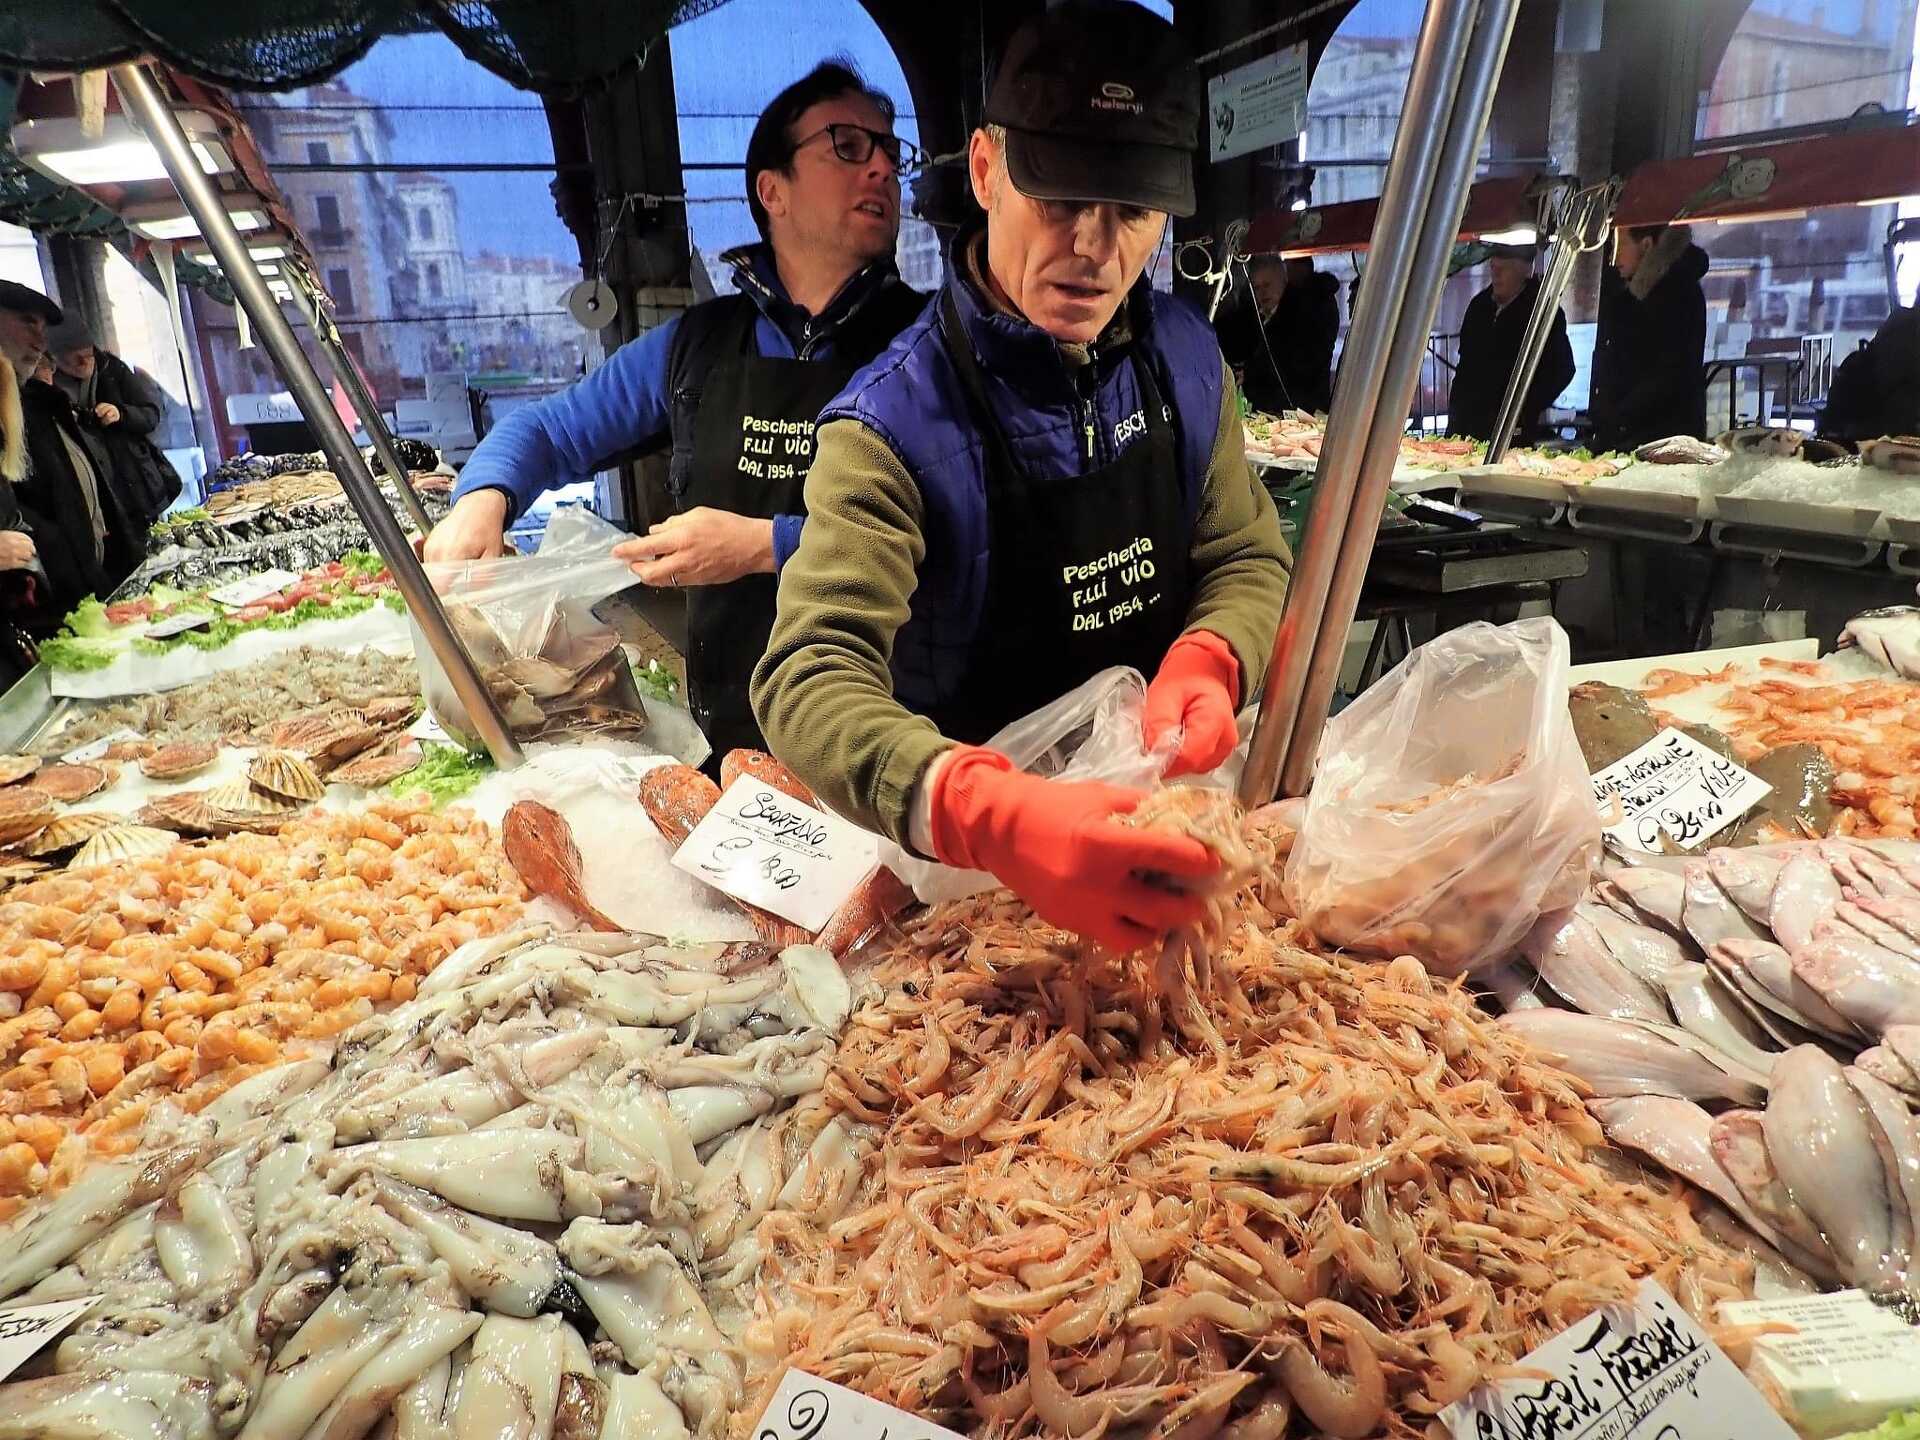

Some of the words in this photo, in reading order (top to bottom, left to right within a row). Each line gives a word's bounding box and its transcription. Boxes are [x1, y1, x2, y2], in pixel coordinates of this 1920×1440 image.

[738, 455, 763, 478] DAL
[767, 463, 795, 480] 1954
[1063, 537, 1154, 584] Pescheria
[1072, 611, 1105, 631] DAL
[1109, 595, 1144, 624] 1954
